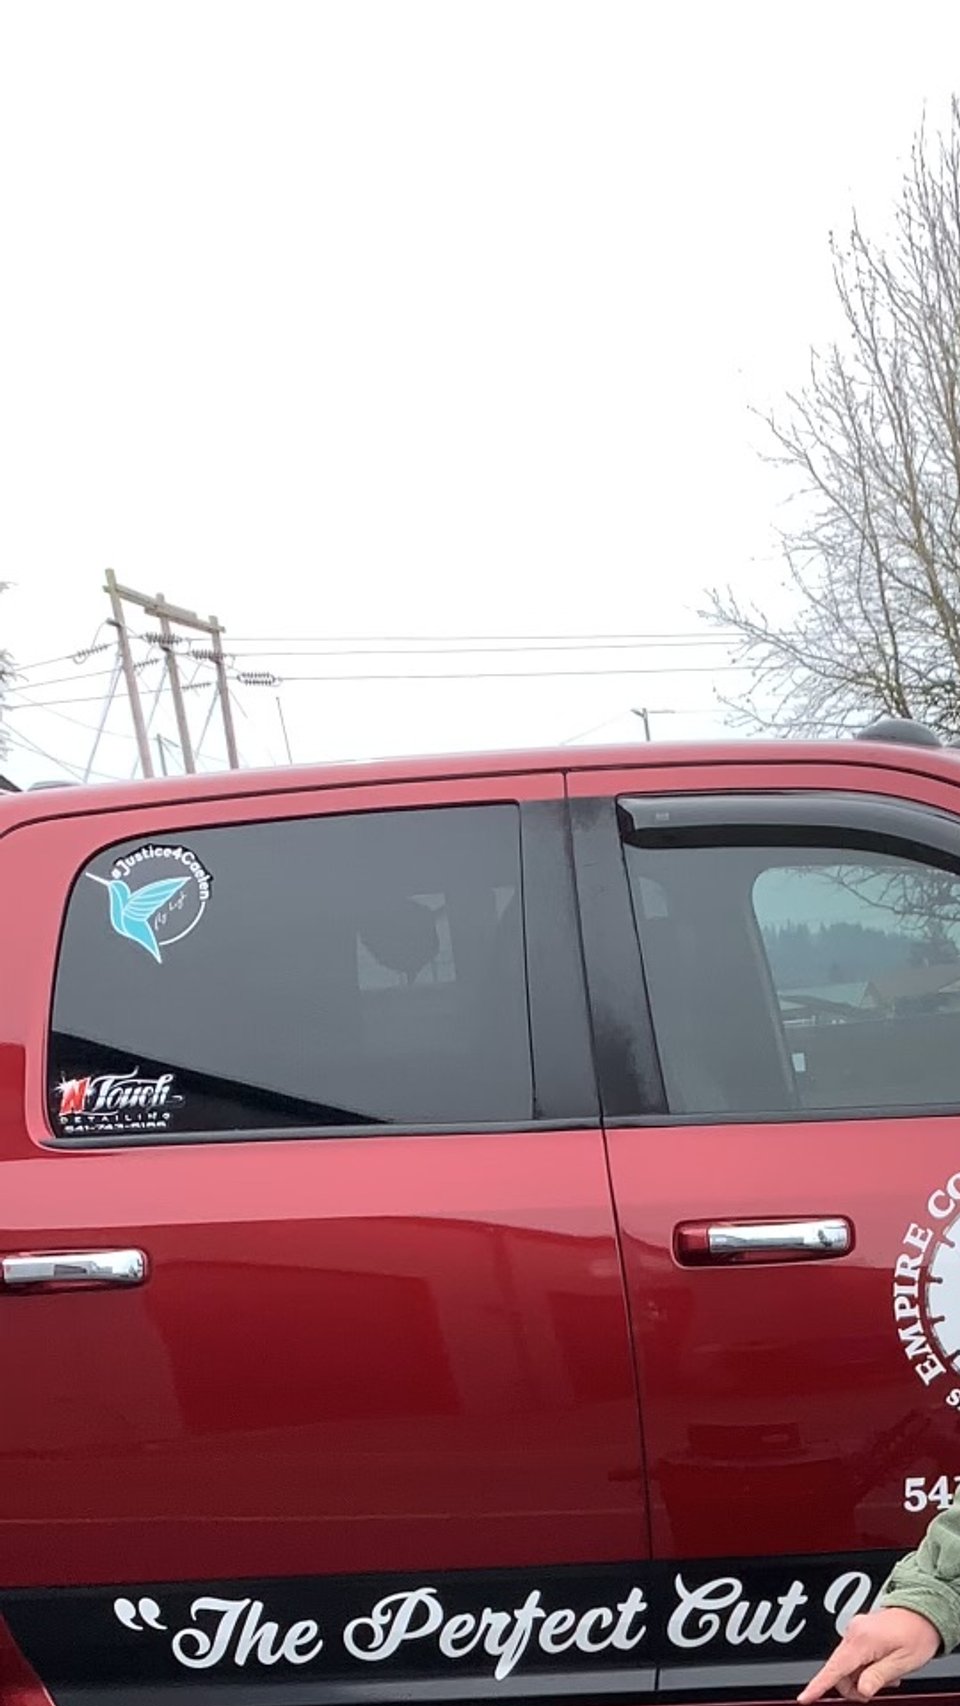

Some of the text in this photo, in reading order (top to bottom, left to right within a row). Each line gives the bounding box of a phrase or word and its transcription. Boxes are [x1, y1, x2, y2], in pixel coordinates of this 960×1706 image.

[892, 1222, 947, 1386] EMPIRE
[343, 1587, 648, 1681] Perfect
[666, 1572, 809, 1648] Cut
